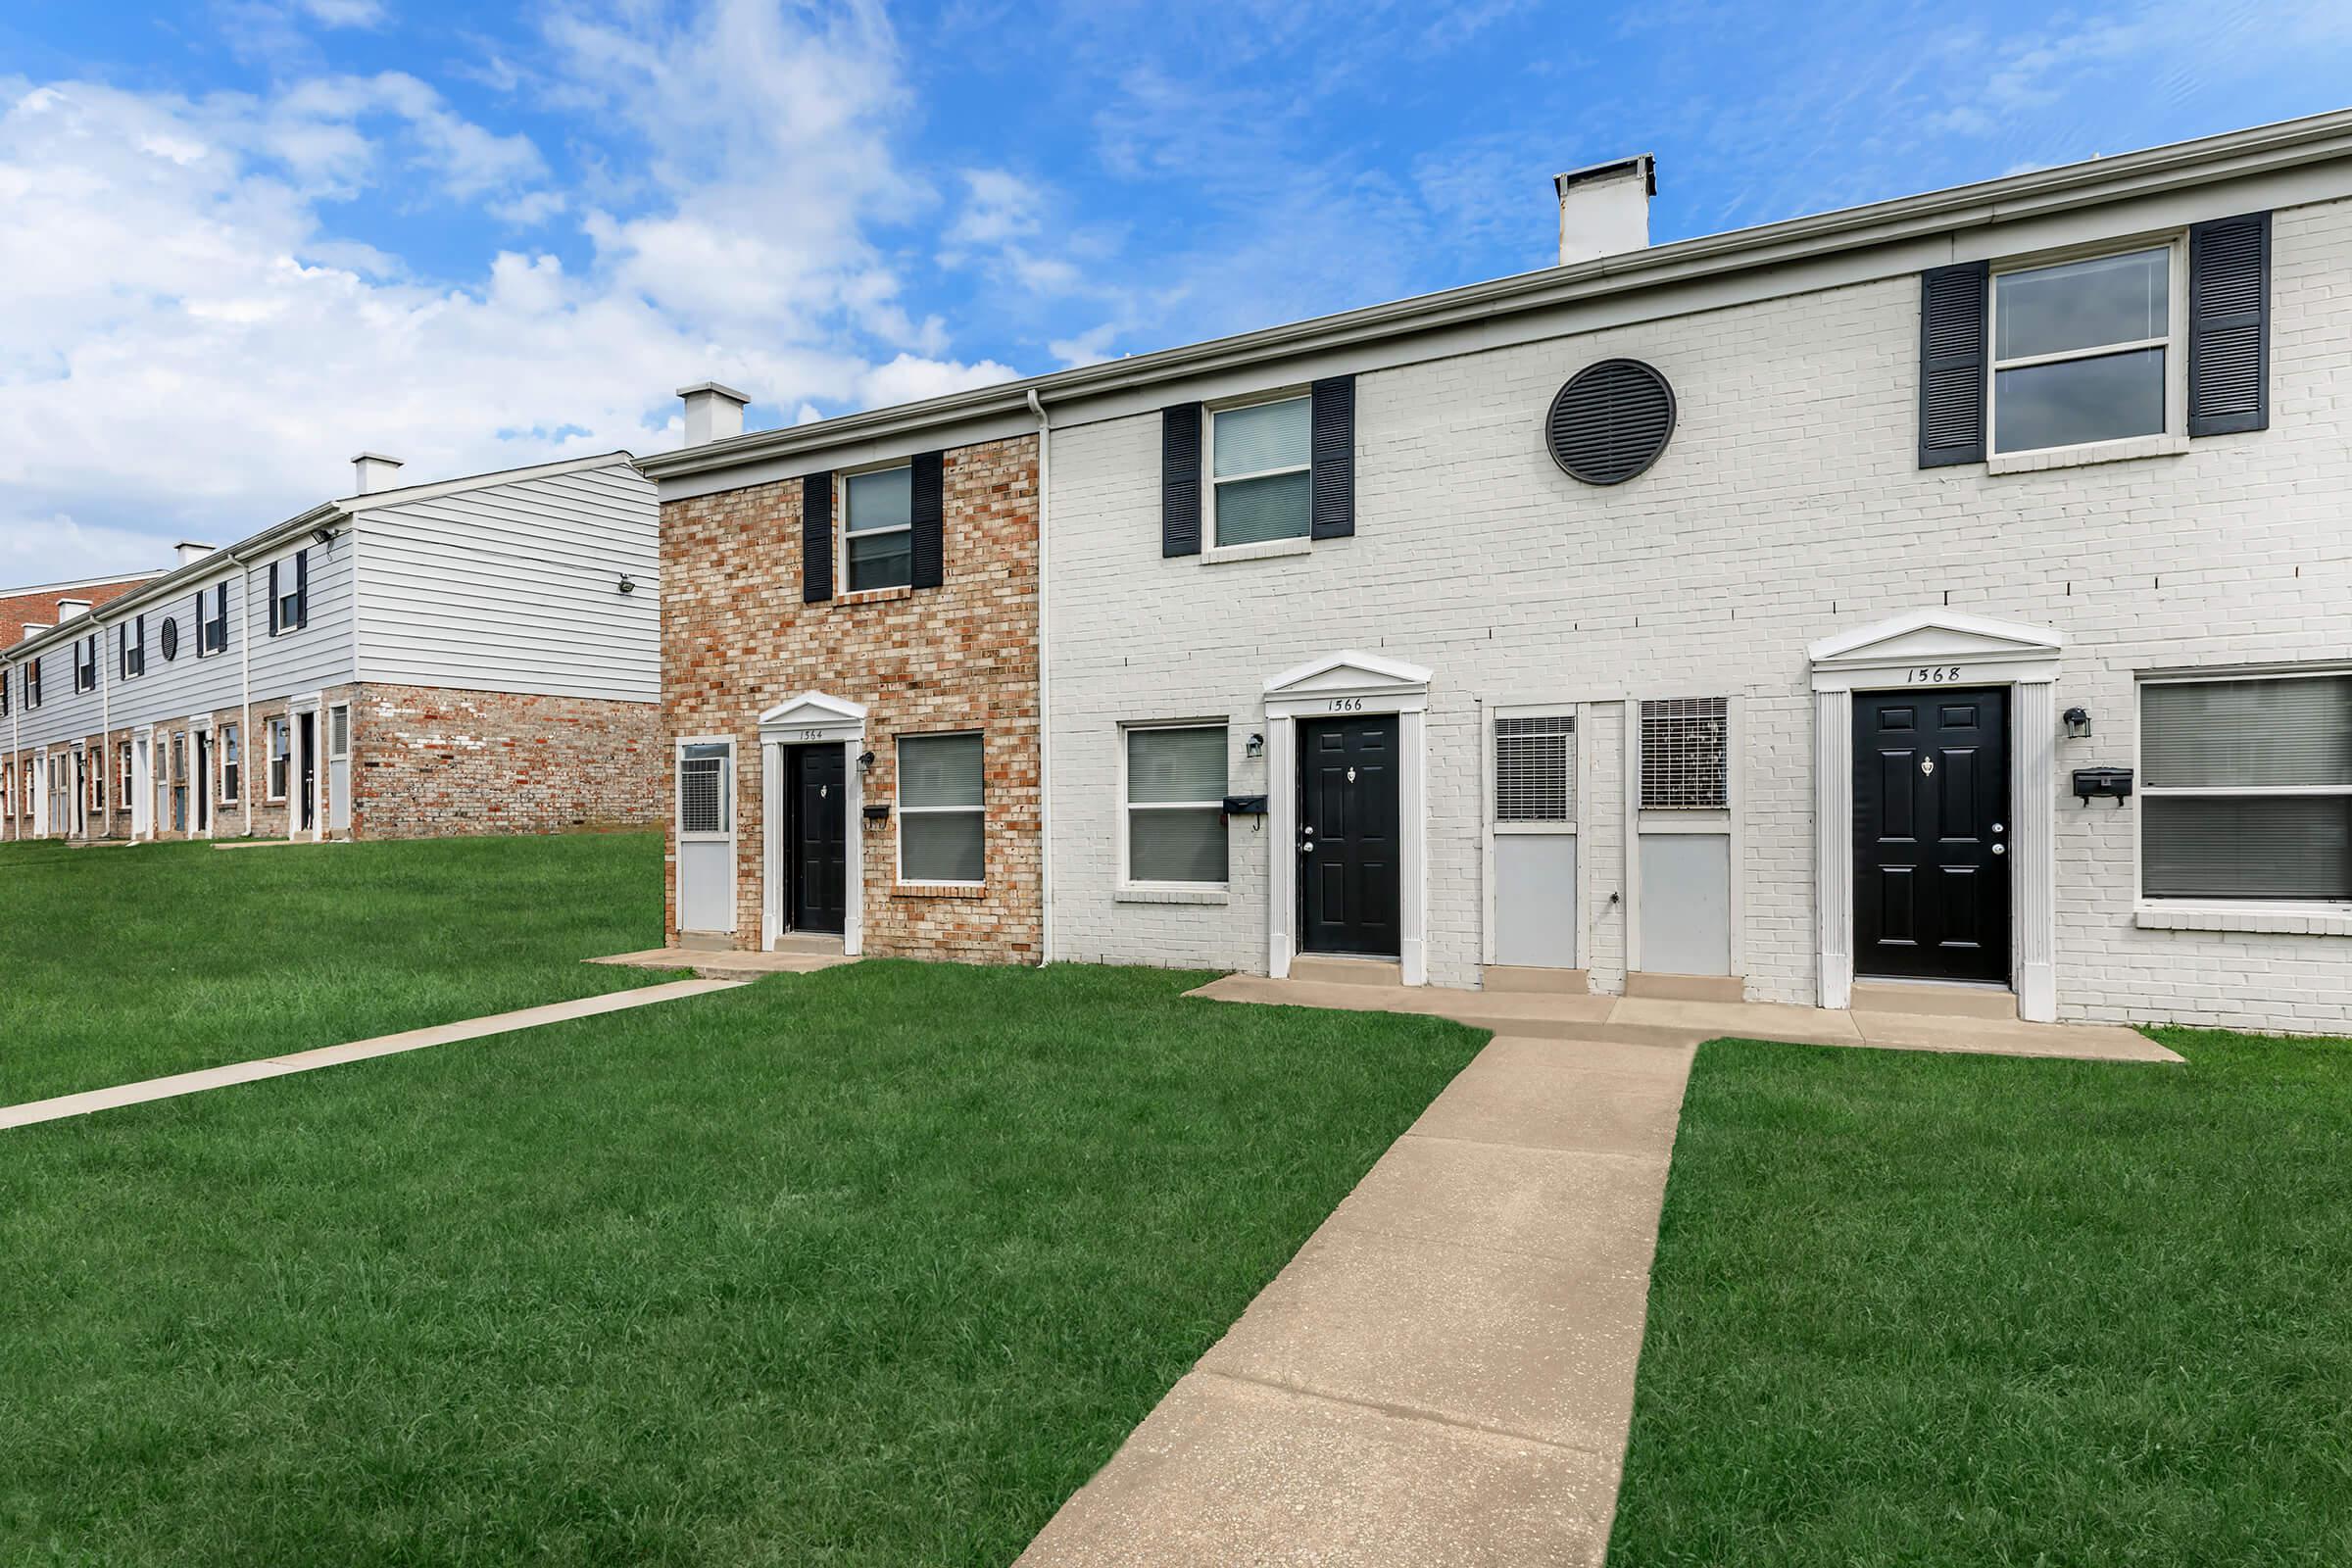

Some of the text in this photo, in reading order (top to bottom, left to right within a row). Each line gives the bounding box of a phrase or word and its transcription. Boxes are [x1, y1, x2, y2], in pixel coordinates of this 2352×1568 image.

[1908, 666, 1961, 682] 1568
[1329, 698, 1362, 711] 1566
[800, 730, 823, 740] 1564
